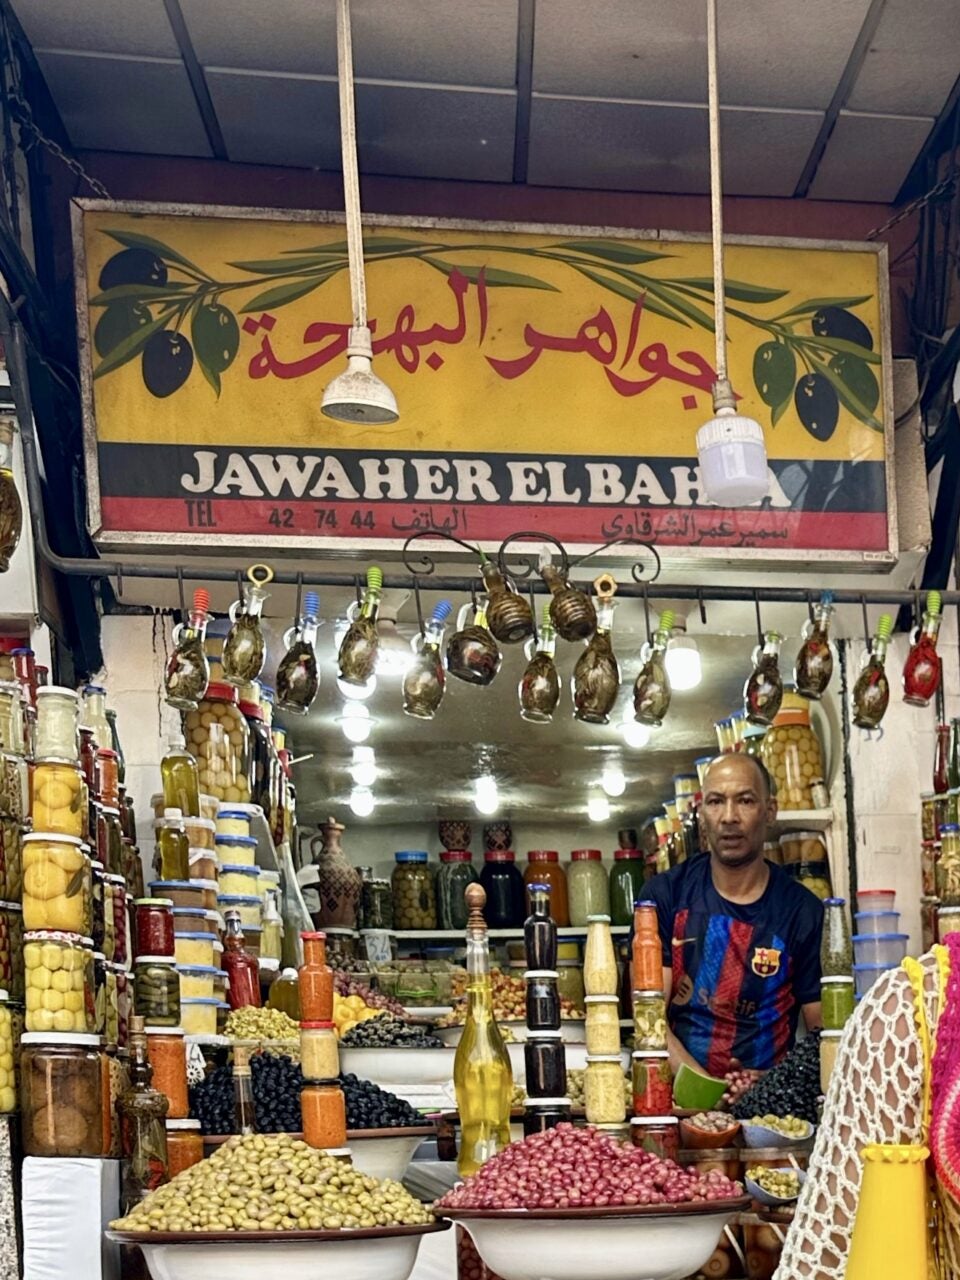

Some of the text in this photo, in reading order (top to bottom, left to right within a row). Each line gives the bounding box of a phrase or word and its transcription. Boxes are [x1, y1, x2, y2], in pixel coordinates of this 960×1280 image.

[484, 287, 744, 410] جواهر
[180, 450, 792, 507] JAWAHER EL BAHA
[184, 500, 376, 530] TEL 42 74 44
[391, 506, 468, 532] الهاتف
